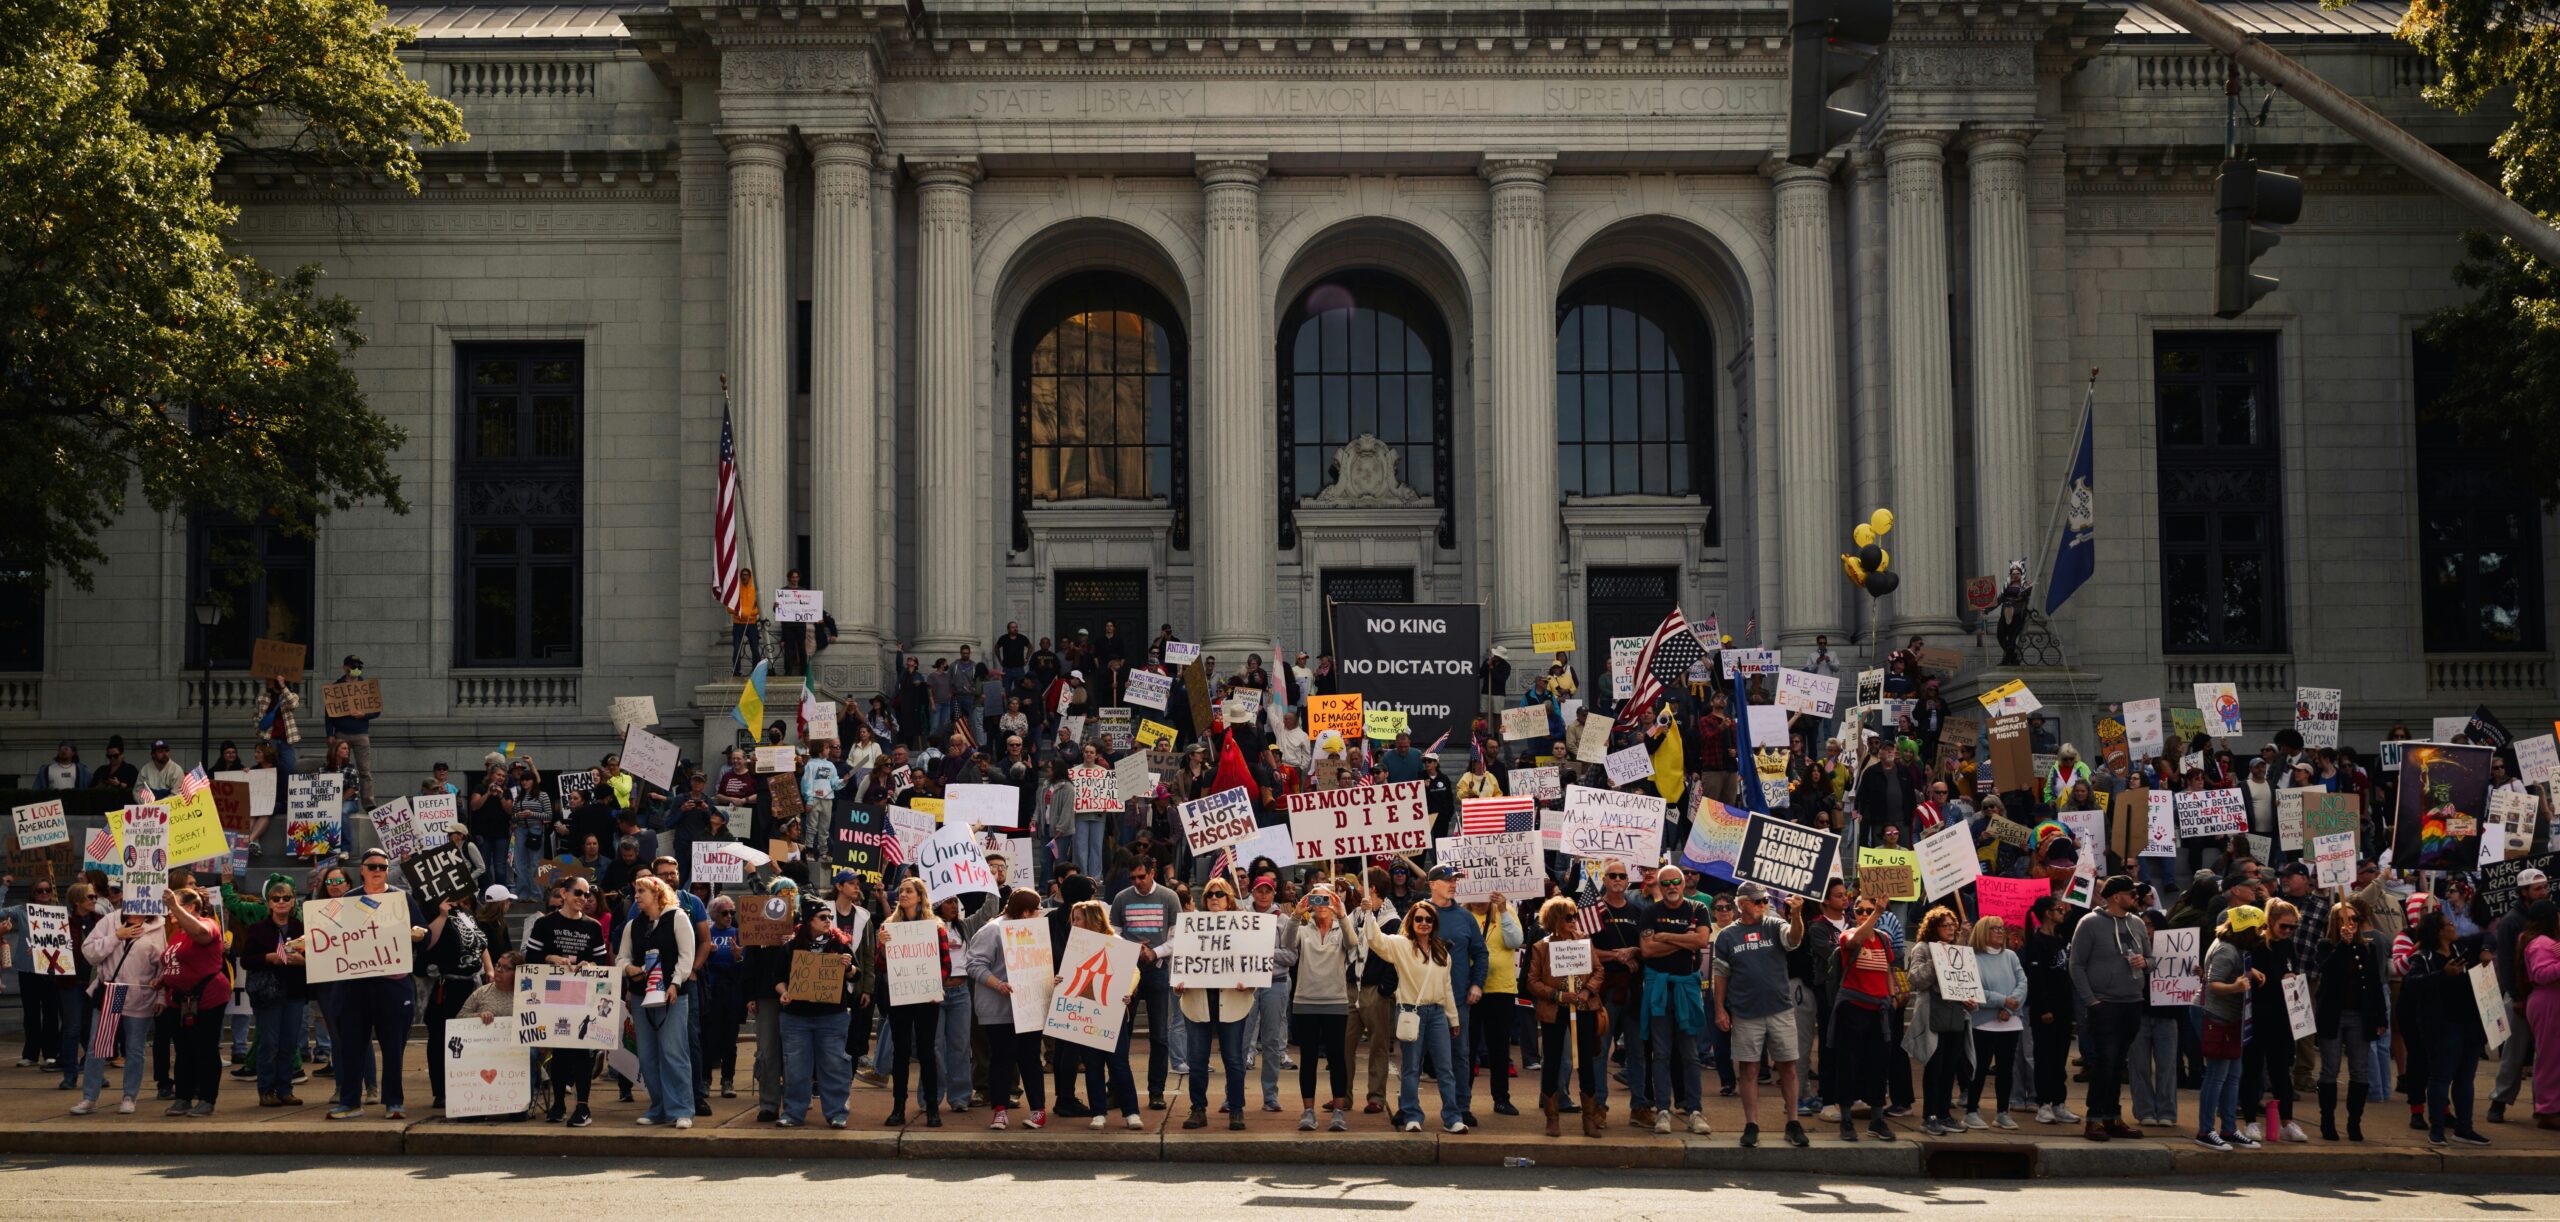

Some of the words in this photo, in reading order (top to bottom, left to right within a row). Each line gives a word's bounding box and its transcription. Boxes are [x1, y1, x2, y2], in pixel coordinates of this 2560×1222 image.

[974, 89, 1054, 112] STATE
[1076, 88, 1193, 112] LIBRARY
[1263, 87, 1412, 111] MEMORIAL
[1422, 87, 1491, 111] HALL
[1547, 87, 1665, 111] SUPREME
[1680, 86, 1776, 110] COURT
[795, 613, 814, 622] DUTY
[1367, 619, 1396, 633] NO
[1400, 618, 1447, 633] KING
[1167, 643, 1188, 654] ANTIFA
[1613, 639, 1647, 650] MONEY
[1344, 660, 1373, 674] NO
[1377, 659, 1473, 674] DICTATOR
[324, 683, 376, 698] RELEASE
[1786, 674, 1834, 693] RELEASE
[2298, 689, 2322, 700] Elect
[326, 701, 350, 714] THE
[354, 697, 382, 711] FILES
[1322, 701, 1337, 709] NO
[1363, 701, 1392, 711] NO
[1395, 701, 1450, 718] trump
[1314, 713, 1360, 722] DEMAGOGY
[1369, 714, 1388, 722] Save
[2297, 721, 2327, 732] Expect
[1996, 731, 2020, 740] RIGHTS
[2304, 733, 2336, 745] circus
[299, 773, 320, 781] CANNOT
[560, 773, 593, 784] HUMAN
[1533, 768, 1560, 778] RIGHTS
[1518, 777, 1549, 788] ARE
[299, 787, 315, 795] STILL
[315, 787, 329, 795] HAVE
[332, 786, 341, 794] TO
[1094, 789, 1103, 797] OF
[1291, 781, 1424, 813] DEMOCRACY
[419, 798, 450, 808] DEFEAT
[1075, 799, 1124, 811] EMISSIONS
[1185, 787, 1247, 818] FREEDOM
[1575, 789, 1662, 812] IMMIGRANTS
[2212, 797, 2239, 807] BREAK
[2321, 796, 2345, 811] NO
[16, 809, 28, 822] I
[31, 804, 62, 820] LOVE
[135, 807, 160, 819] LOVE
[295, 811, 313, 819] HANDS
[372, 804, 393, 819] ONLY
[389, 809, 411, 824] WE
[419, 809, 455, 819] FASCISTS
[851, 810, 870, 824] NO
[1203, 804, 1237, 827] NOT
[2179, 810, 2199, 819] YOUR
[2225, 805, 2246, 814] THEN
[18, 818, 65, 834] AMERICAN
[1563, 809, 1594, 825] Make
[1601, 812, 1657, 829] AMERICA
[1991, 819, 2009, 830] FREE
[2180, 818, 2195, 827] YOU
[2307, 812, 2359, 829] KINGS
[1188, 815, 1255, 850] FASCISM
[1762, 822, 1824, 851] VETERANS
[1996, 828, 2028, 839] SPEECH
[2181, 828, 2198, 836] HER
[2204, 823, 2239, 834] ENOUGH
[20, 830, 67, 847] DEMOCRACY
[134, 835, 161, 847] GREAT
[839, 828, 880, 847] KINGS
[1452, 838, 1472, 848] IN
[1478, 834, 1513, 845] TIMES
[1516, 832, 1527, 841] OF
[1573, 828, 1641, 850] GREAT
[2320, 836, 2339, 844] LIKE
[2340, 833, 2353, 842] MY
[1296, 840, 1323, 860] IN
[1335, 830, 1426, 856] SILENCE
[1437, 846, 1490, 861] UNIVERSAL
[1497, 843, 1535, 856] DECEIT
[848, 849, 868, 864] NO
[1504, 856, 1531, 866] THE
[1756, 838, 1820, 871] AGAINST
[1864, 855, 1884, 865] The
[1890, 855, 1906, 866] US
[2315, 850, 2355, 863] CRUSHED
[414, 848, 463, 883] FUCK
[2526, 855, 2554, 869] NOT
[126, 872, 167, 885] FIGHTING
[1474, 868, 1501, 880] WILL
[1504, 867, 1521, 877] BE
[1524, 866, 1533, 876] A
[1752, 858, 1814, 892] TRUMP
[1861, 867, 1909, 883] WORKERS
[929, 870, 951, 891] La
[1520, 878, 1541, 889] ACT
[137, 886, 150, 897] FOR
[1865, 882, 1907, 897] UNITE
[29, 905, 66, 920] Dethrone
[741, 903, 758, 913] NO
[42, 921, 55, 930] the
[894, 925, 924, 936] THE
[1184, 915, 1260, 934] RELEASE
[311, 921, 379, 953] Deport
[1198, 935, 1231, 951] THE
[2166, 932, 2194, 953] NO
[887, 943, 938, 959] REVOLUTION
[1733, 944, 1746, 953] NOT
[1747, 942, 1758, 951] FOR
[1759, 939, 1774, 948] SALE
[336, 936, 401, 973] Donald!
[796, 953, 815, 966] NO
[520, 966, 539, 975] This
[549, 966, 565, 976] Is
[574, 967, 610, 979] America
[894, 965, 913, 977] WILL
[915, 963, 928, 975] BE
[1173, 956, 1234, 975] EPSTEIN
[1241, 956, 1274, 973] FILES
[792, 968, 811, 979] NO
[819, 968, 838, 979] KKK
[1944, 970, 1974, 982] CITIZEN
[793, 981, 812, 994] NO
[2152, 980, 2178, 992] FUCK
[815, 991, 834, 1001] USA
[1056, 997, 1084, 1012] Elect
[1093, 1008, 1101, 1016] a
[520, 1011, 537, 1026] NO
[1068, 1011, 1093, 1023] Clown
[519, 1028, 547, 1044] KING
[1048, 1018, 1071, 1029] Expect
[1084, 1026, 1115, 1040] CIRCUS
[500, 1070, 526, 1078] LOVE
